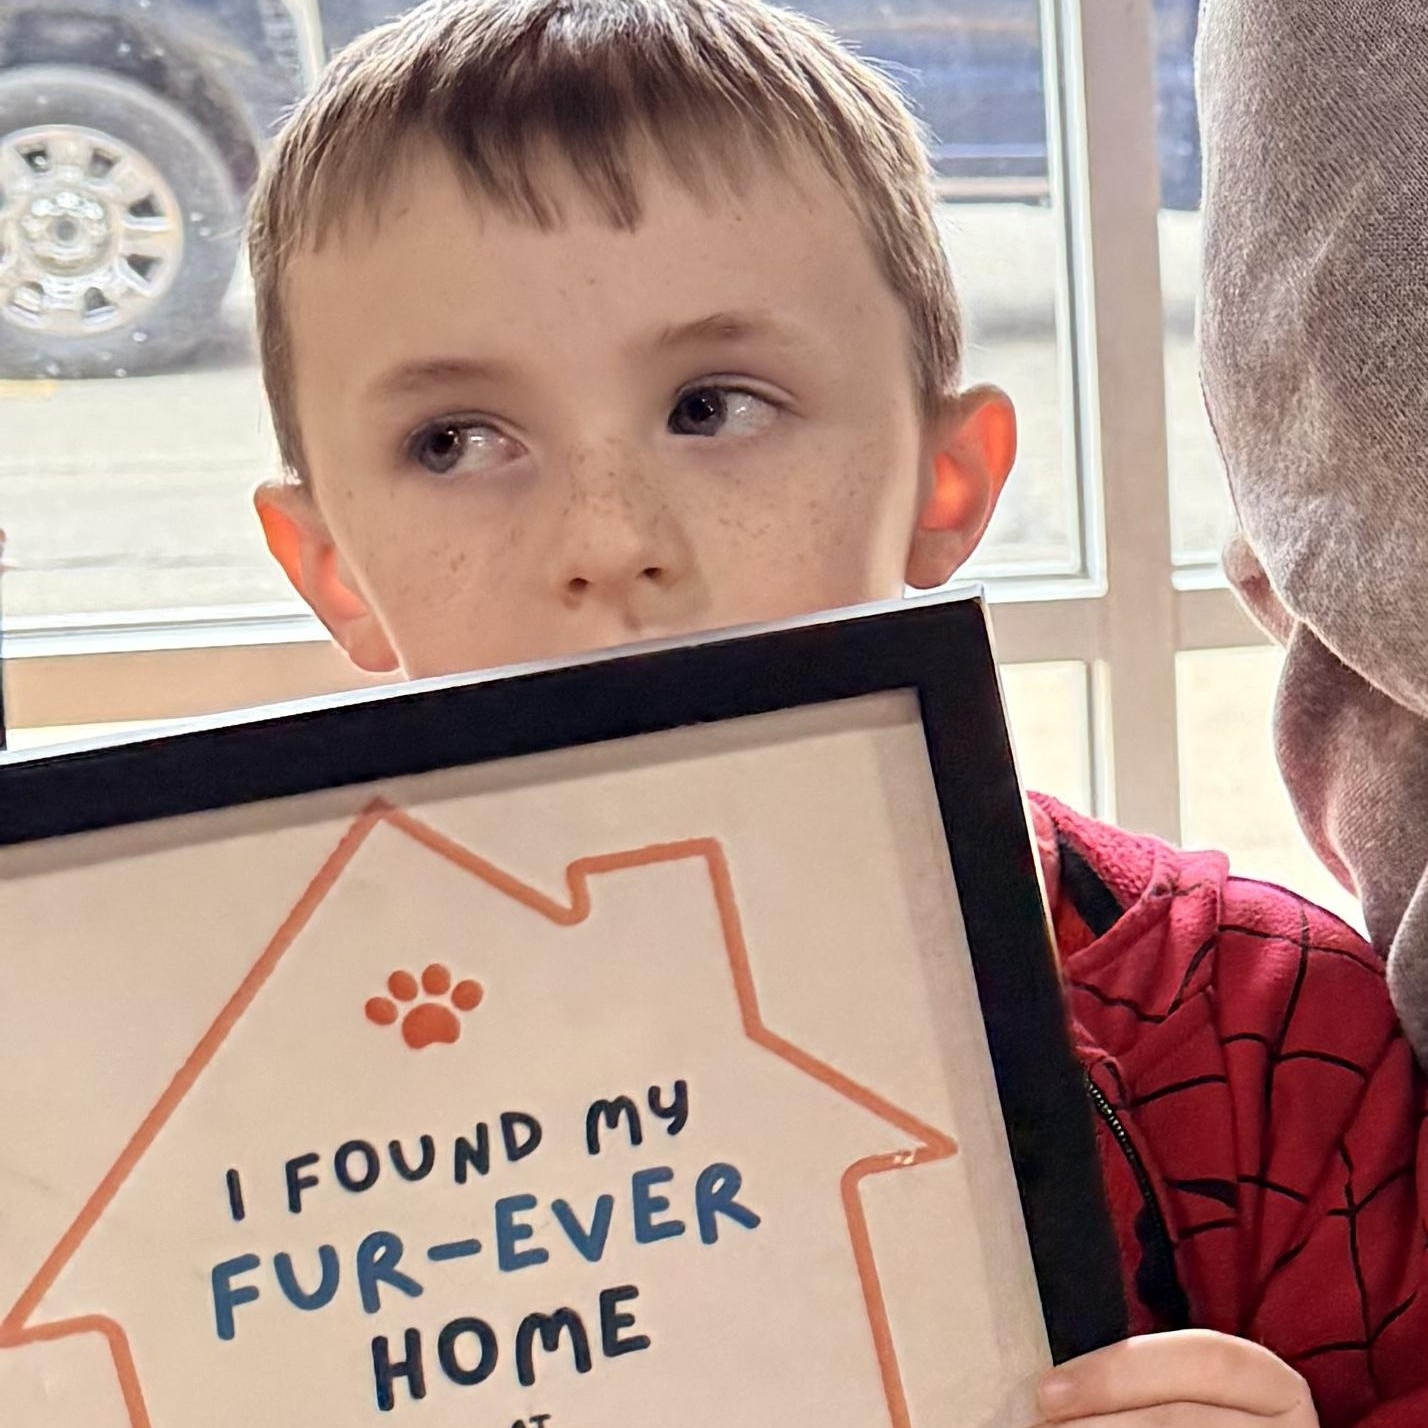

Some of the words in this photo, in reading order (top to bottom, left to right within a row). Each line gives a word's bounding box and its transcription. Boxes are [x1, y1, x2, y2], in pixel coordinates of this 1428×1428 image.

[225, 1168, 246, 1221] I
[285, 1111, 543, 1214] FOUND
[585, 1079, 689, 1156] MY
[211, 1162, 761, 1341] FUR-EVER
[371, 1284, 651, 1412] HOME
